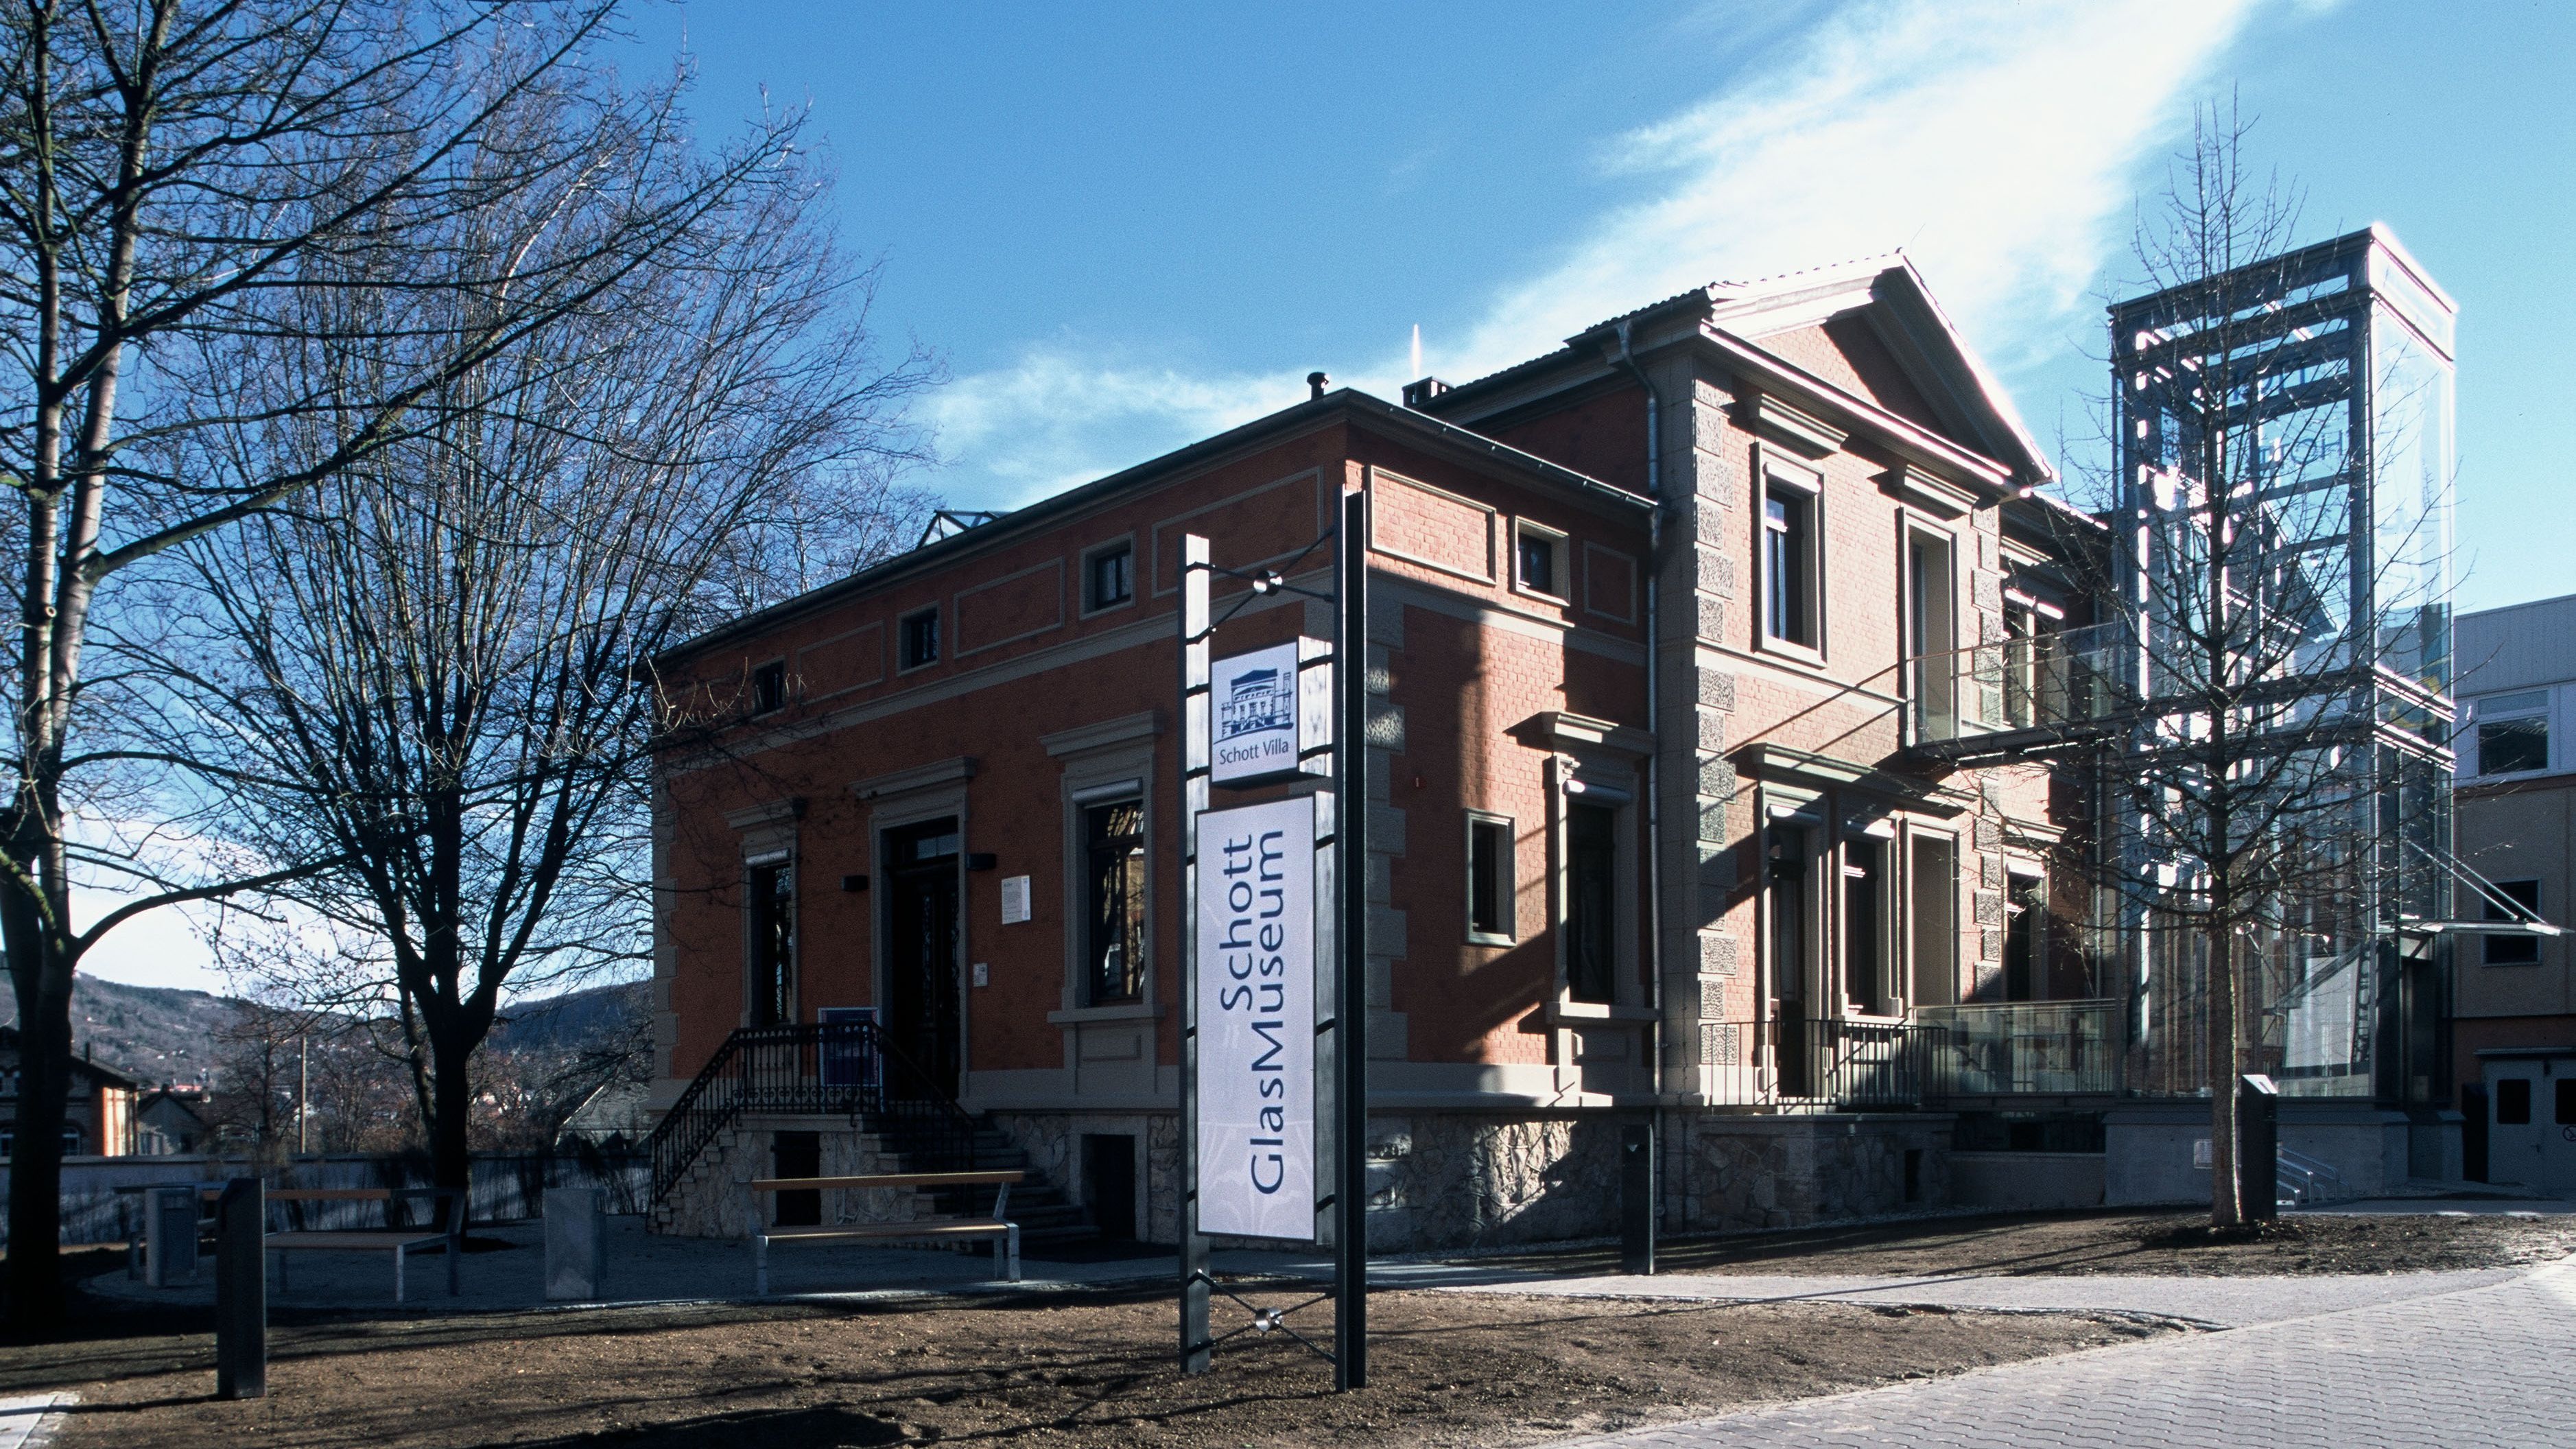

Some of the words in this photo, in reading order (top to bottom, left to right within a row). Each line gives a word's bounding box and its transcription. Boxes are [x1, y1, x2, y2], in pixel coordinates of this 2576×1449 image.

[1220, 745, 1259, 765] Schott
[1264, 738, 1288, 756] Villa
[1219, 834, 1253, 1011] Schott
[1250, 830, 1284, 1195] GlasMuseum
